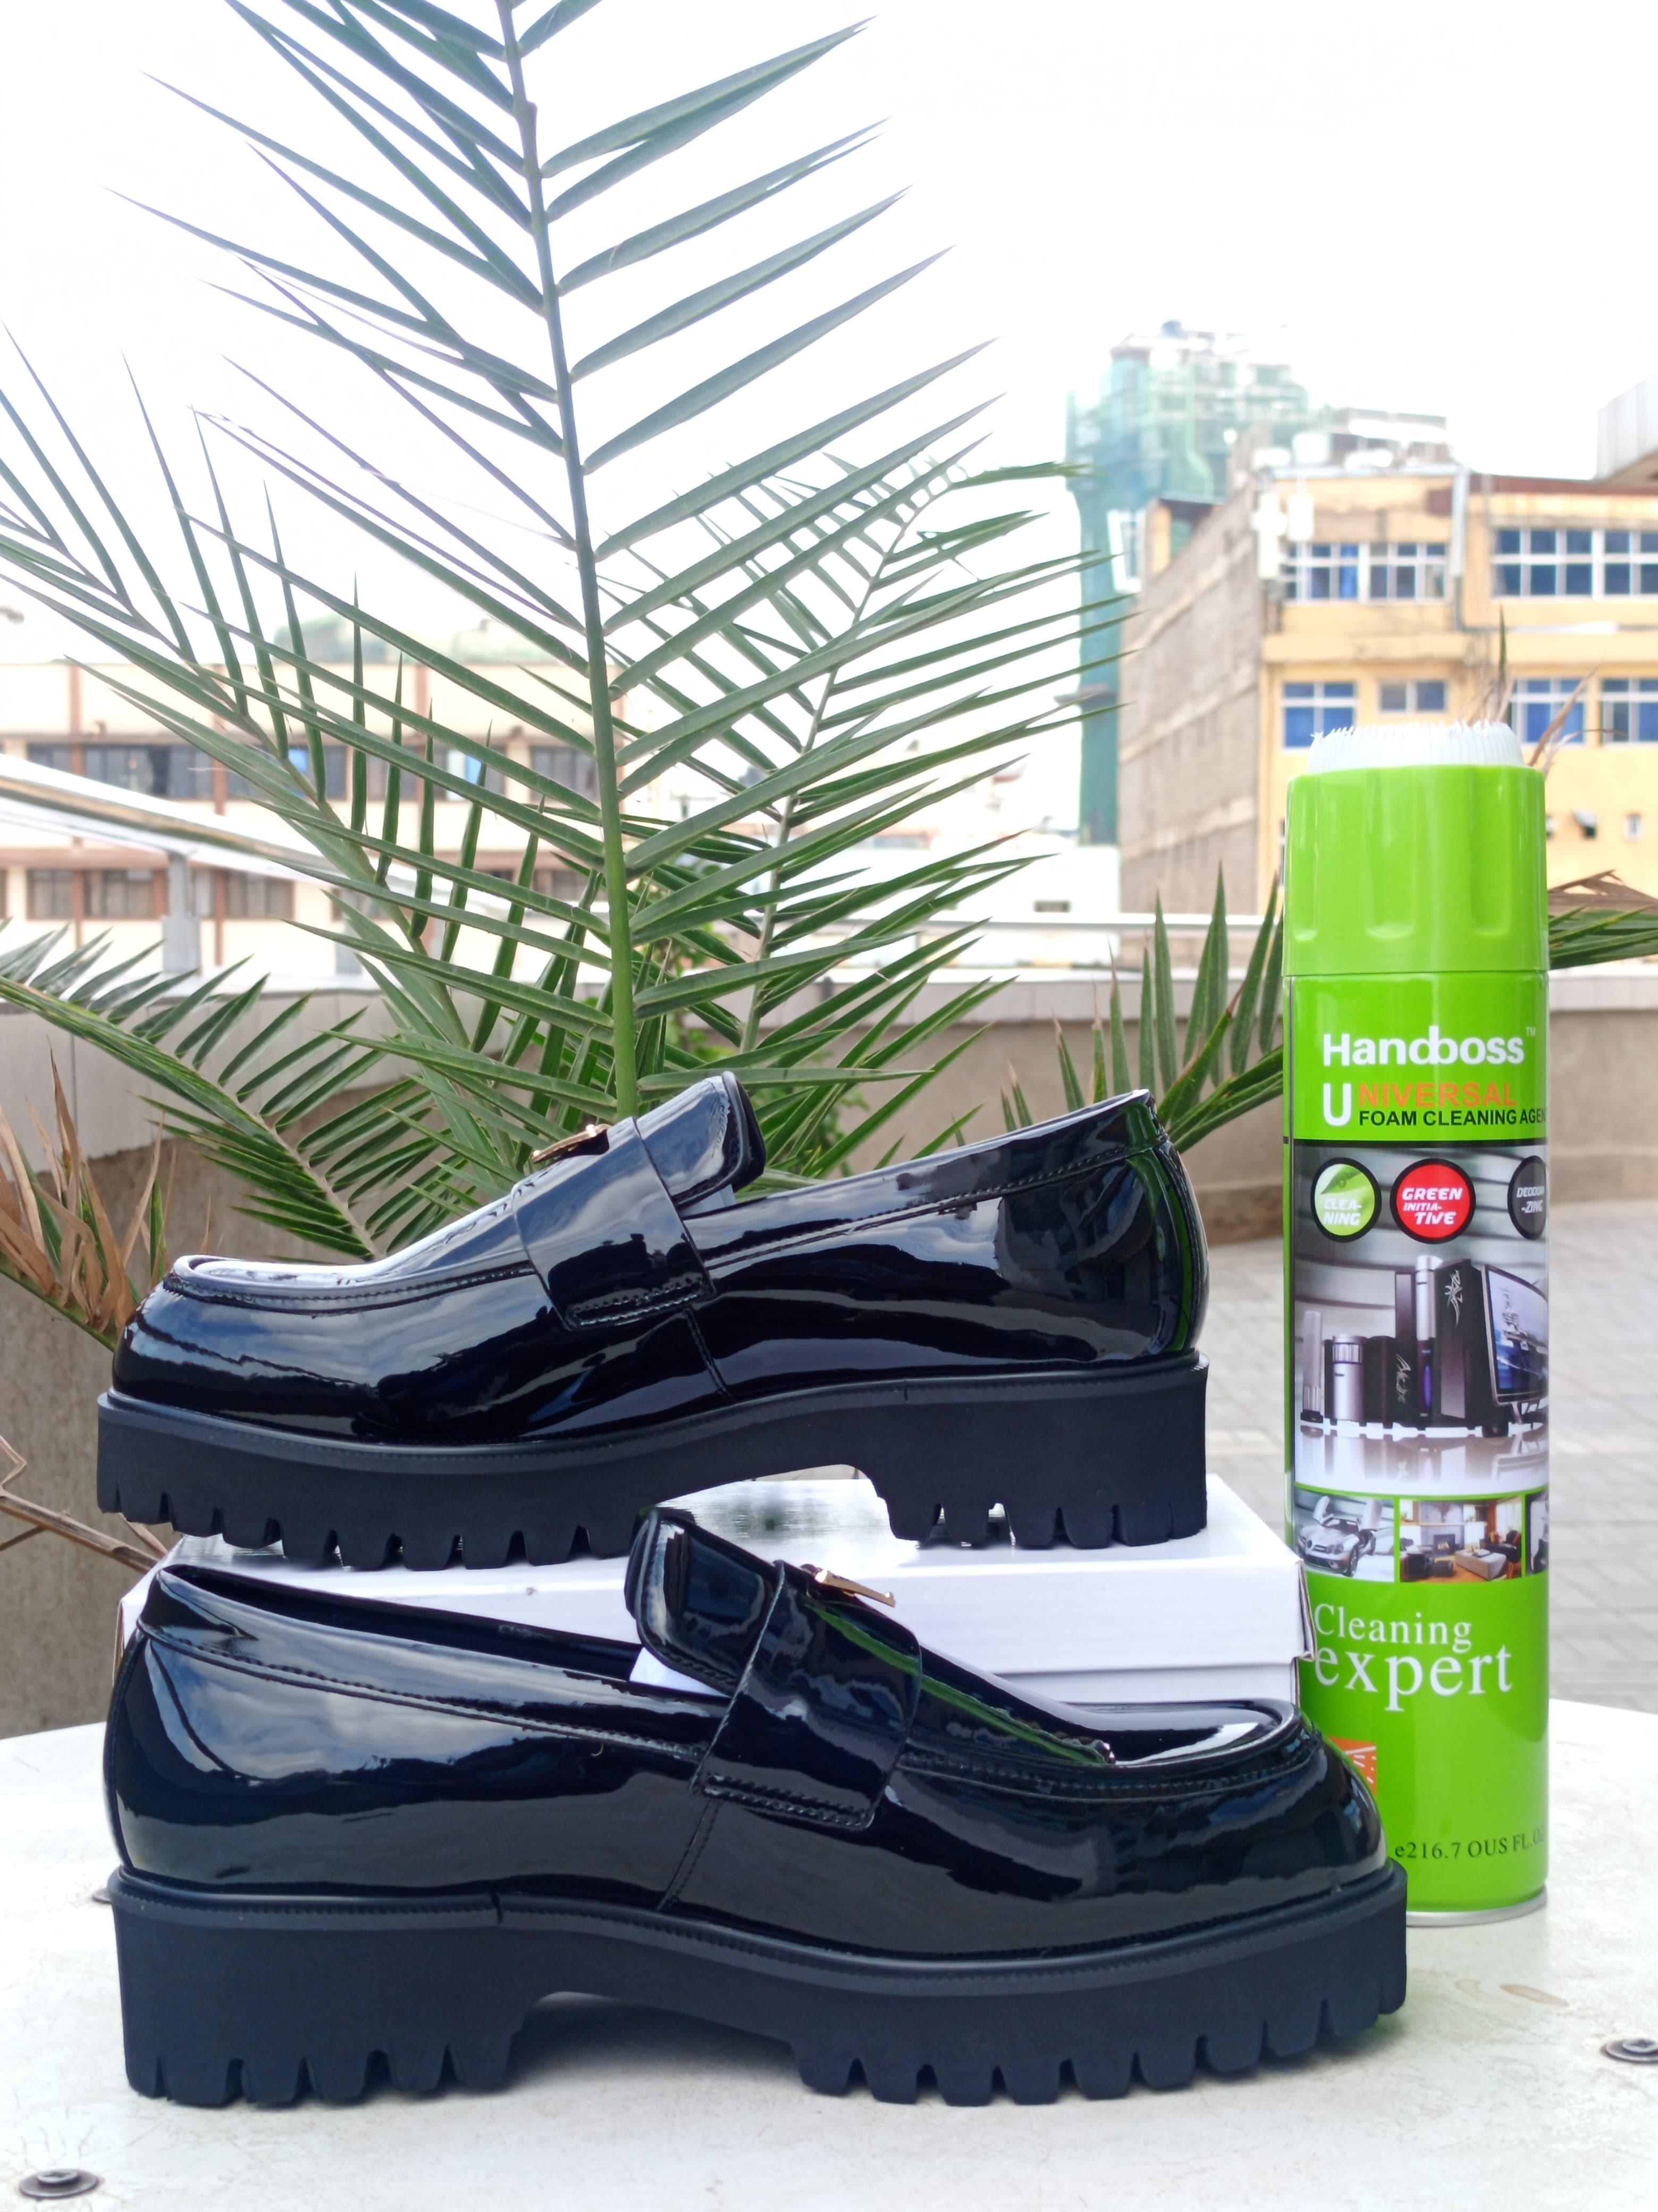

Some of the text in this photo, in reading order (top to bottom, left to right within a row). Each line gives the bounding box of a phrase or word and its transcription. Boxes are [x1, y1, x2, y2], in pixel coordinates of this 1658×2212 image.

[1323, 1025, 1525, 1067] Handboss
[1359, 1108, 1548, 1126] FOAM CLEANING AGEN
[1402, 1187, 1463, 1201] GREEN
[1403, 1202, 1442, 1212] INITIA-
[1323, 1212, 1361, 1226] NING
[1314, 1603, 1472, 1654] Cleaning
[1315, 1644, 1513, 1712] expert
